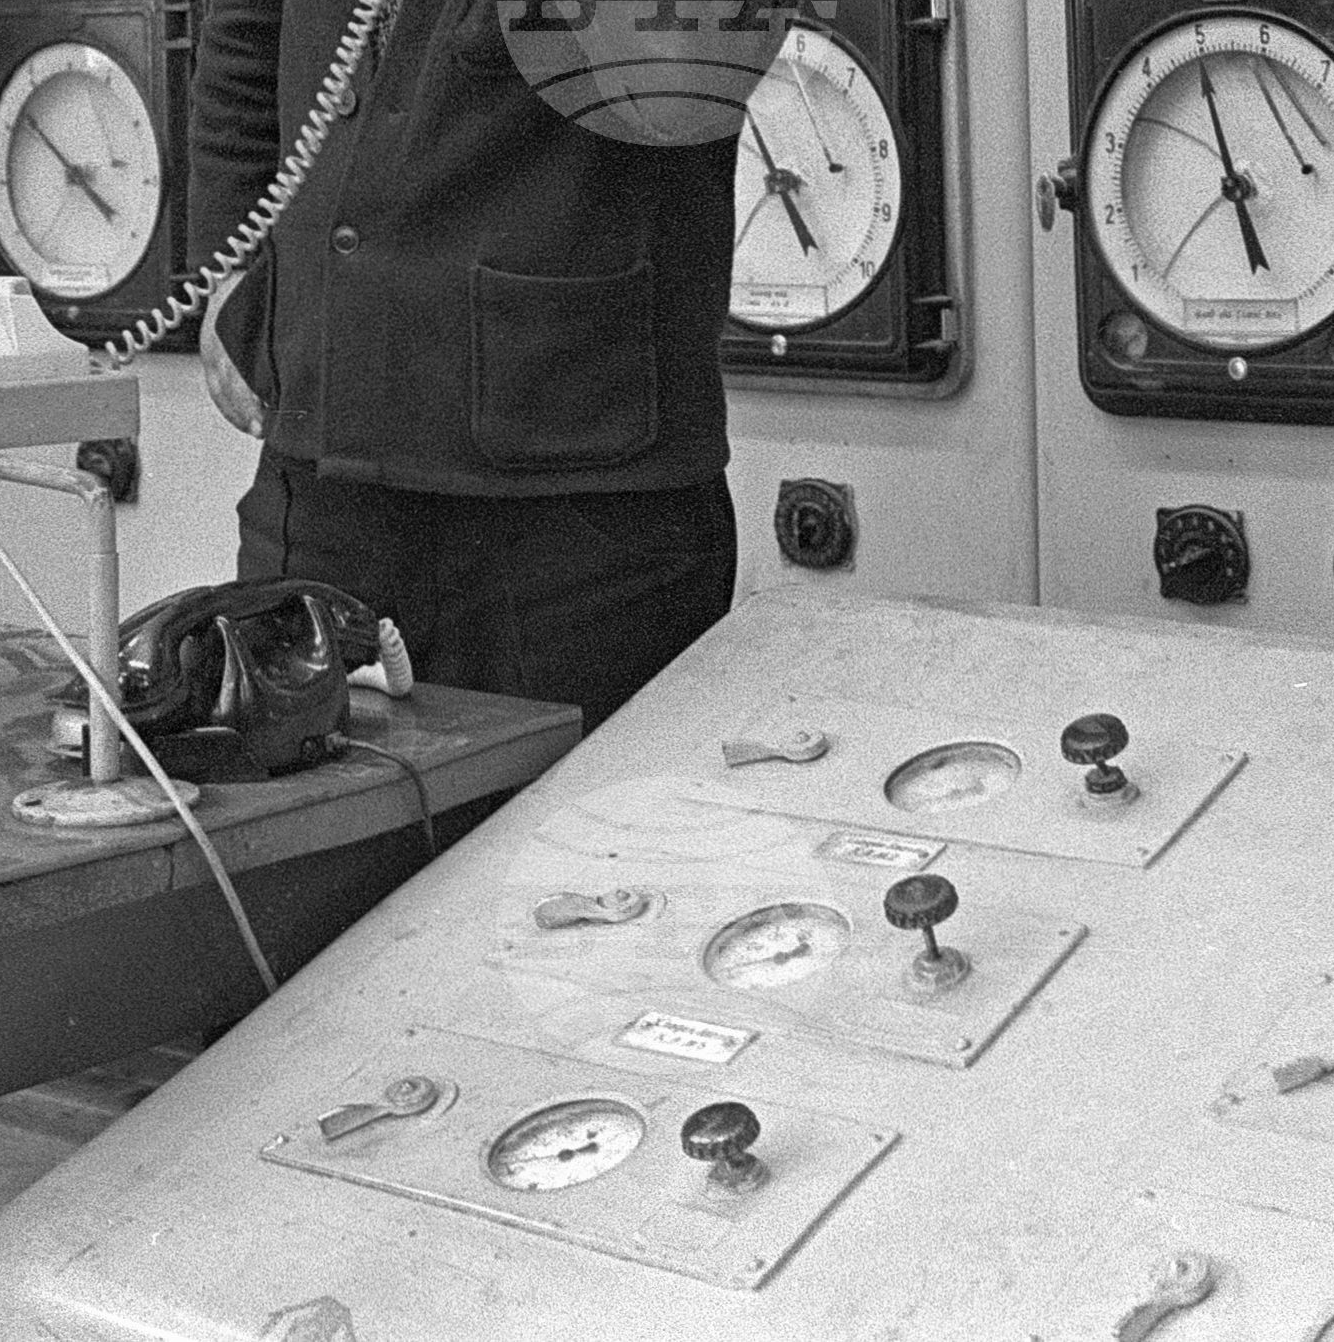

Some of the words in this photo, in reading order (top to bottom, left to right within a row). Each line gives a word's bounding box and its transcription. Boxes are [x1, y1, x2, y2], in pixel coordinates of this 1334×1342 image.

[796, 34, 806, 53] 6
[1194, 25, 1205, 45] 5
[1259, 25, 1270, 45] 6
[1141, 57, 1153, 77] 4
[1319, 60, 1331, 80] 7
[846, 68, 856, 87] 7
[879, 140, 889, 159] 8
[1105, 133, 1116, 154] 3
[881, 204, 892, 223] 9
[1105, 205, 1117, 225] 2
[859, 260, 876, 278] 10
[1131, 263, 1139, 282] 1
